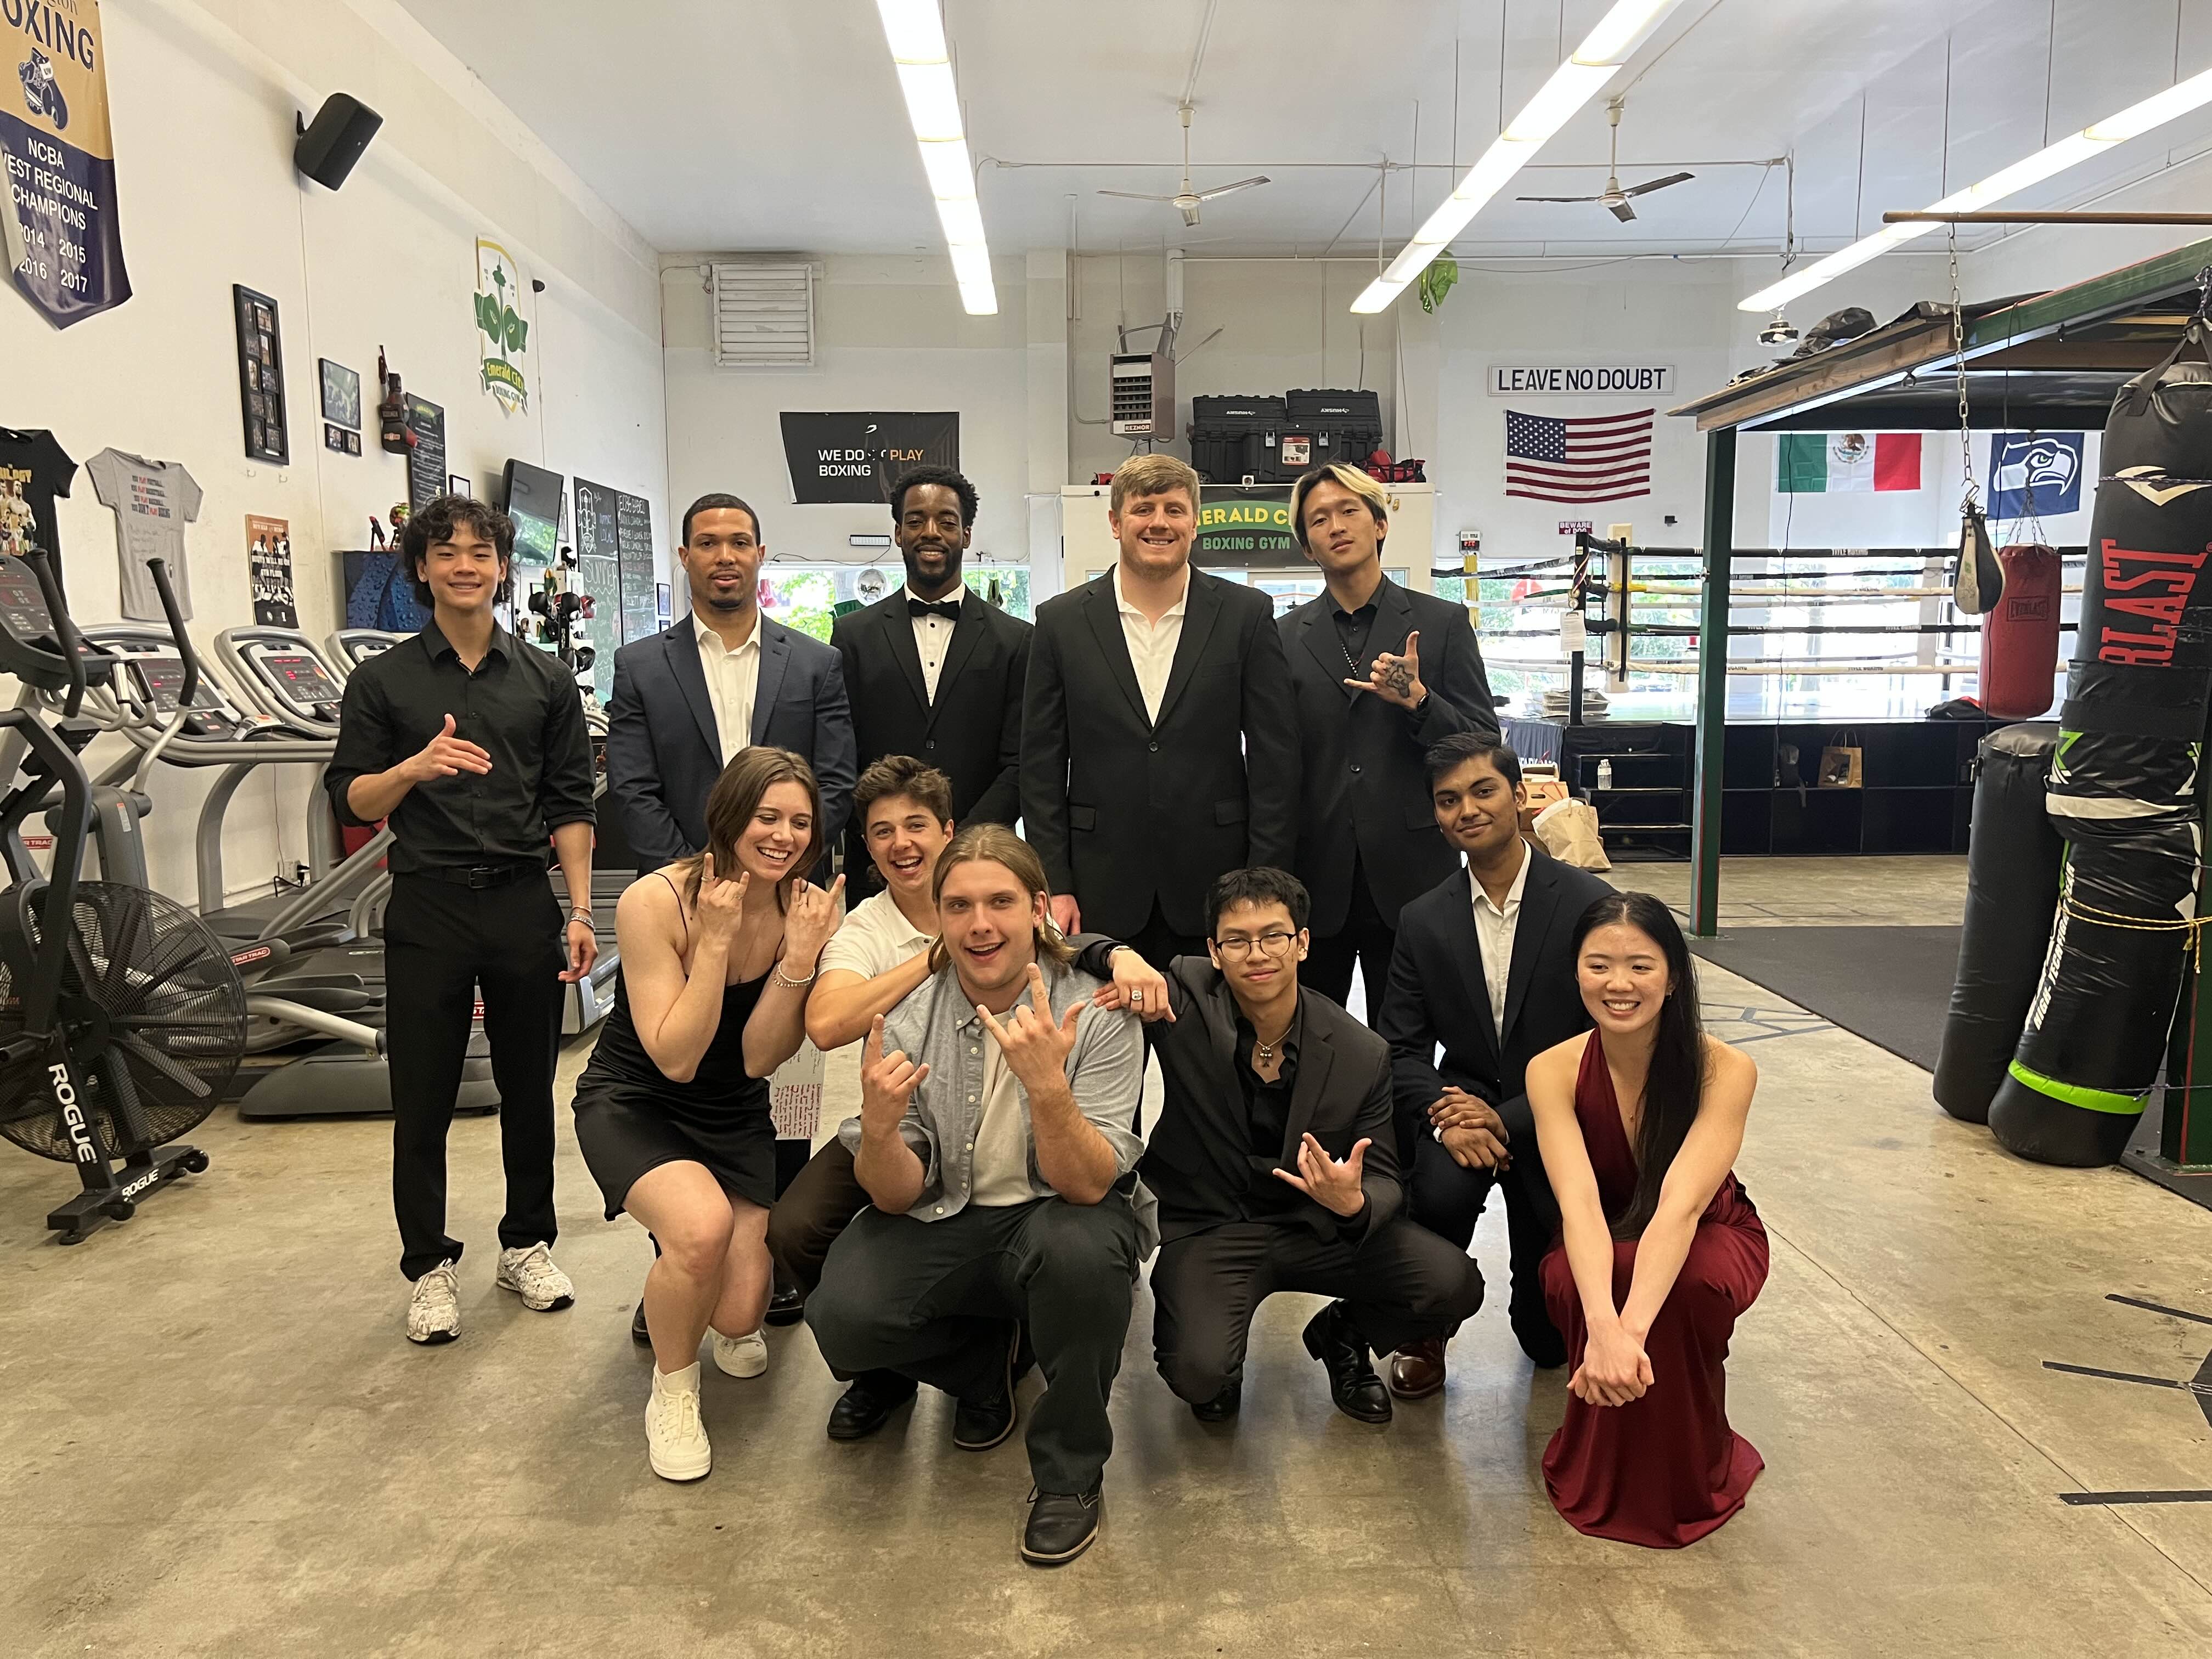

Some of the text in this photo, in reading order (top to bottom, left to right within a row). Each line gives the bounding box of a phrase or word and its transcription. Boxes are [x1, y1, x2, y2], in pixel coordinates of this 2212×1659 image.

[0, 0, 94, 72] OXING
[28, 137, 65, 170] NCBA
[35, 167, 98, 210] REGIONAL
[11, 183, 86, 230] CHAMPIONS
[59, 239, 86, 263] 2015
[60, 269, 87, 292] 2017
[487, 362, 511, 381] Emerald
[1498, 369, 1666, 391] LEAVE NO DOUBT
[818, 450, 841, 461] WE
[845, 450, 865, 461] DO
[890, 449, 924, 461] PLAY
[819, 465, 871, 476] BOXING
[1197, 507, 1268, 526] ERALD
[1203, 537, 1290, 550] BOXING GYM
[2098, 539, 2208, 667] RLAST
[2048, 943, 2064, 986] TECH
[2063, 861, 2075, 904] EAR
[247, 950, 267, 958] TRAC
[48, 1063, 97, 1163] ROGUE
[122, 1168, 159, 1198] ROGUE
